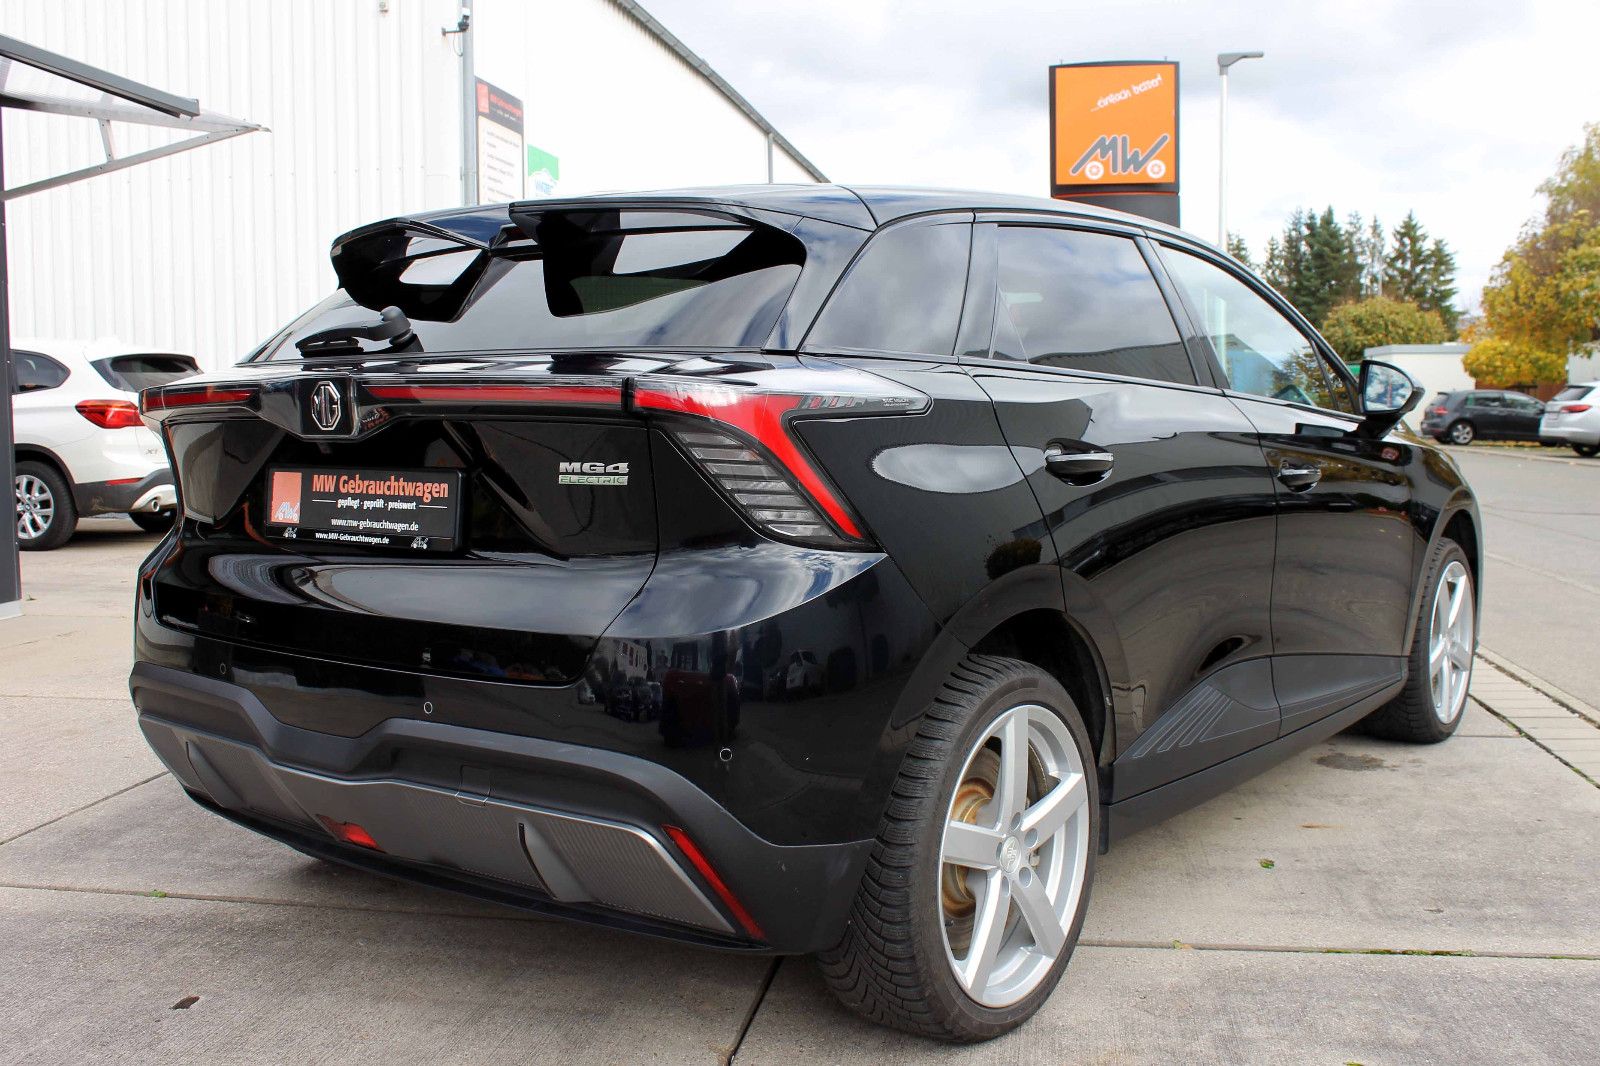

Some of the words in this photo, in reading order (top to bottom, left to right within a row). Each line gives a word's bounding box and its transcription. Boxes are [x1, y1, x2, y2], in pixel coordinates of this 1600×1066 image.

[1069, 133, 1169, 175] MW
[560, 462, 629, 474] MG4
[560, 475, 628, 485] ELECTRIC
[312, 474, 336, 493] MW
[339, 474, 449, 503] Gebrauchtwagen
[337, 497, 360, 510] gepflegt
[363, 498, 385, 510] geprüft
[388, 500, 417, 511] preiswert
[331, 518, 419, 532] www.mw-gebrauchtwagen.de
[315, 531, 390, 545] www.MW-Gebrauchtwagen.de
